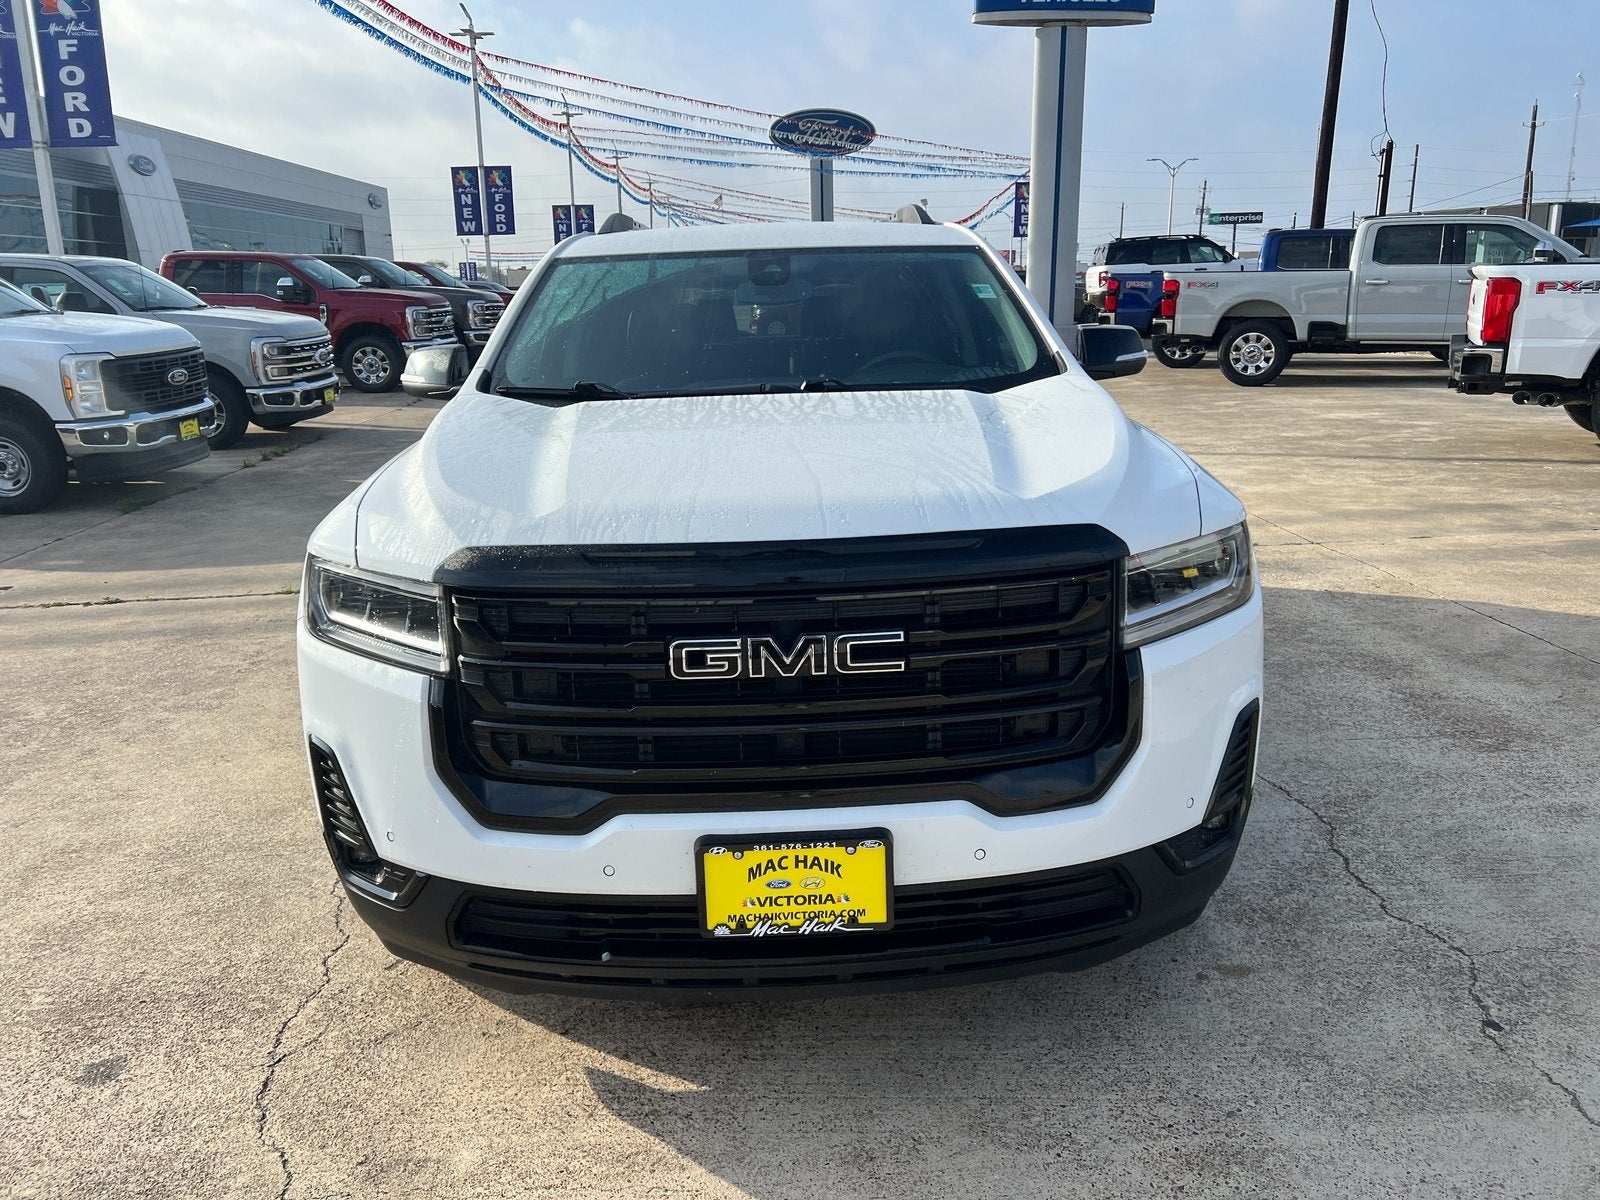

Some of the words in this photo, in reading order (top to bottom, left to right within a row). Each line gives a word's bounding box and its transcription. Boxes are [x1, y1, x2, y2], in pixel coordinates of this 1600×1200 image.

[58, 39, 92, 138] FORD
[461, 194, 475, 232] NEW
[494, 194, 506, 232] FORD
[1213, 213, 1262, 223] enterprise
[1187, 281, 1218, 289] FX4
[1536, 280, 1600, 294] FX4
[669, 631, 905, 680] GMC
[747, 855, 789, 883] MAC
[794, 854, 843, 880] HAIK
[756, 893, 836, 908] VICTORIA
[744, 919, 797, 938] Mac
[797, 916, 855, 935] Haik
